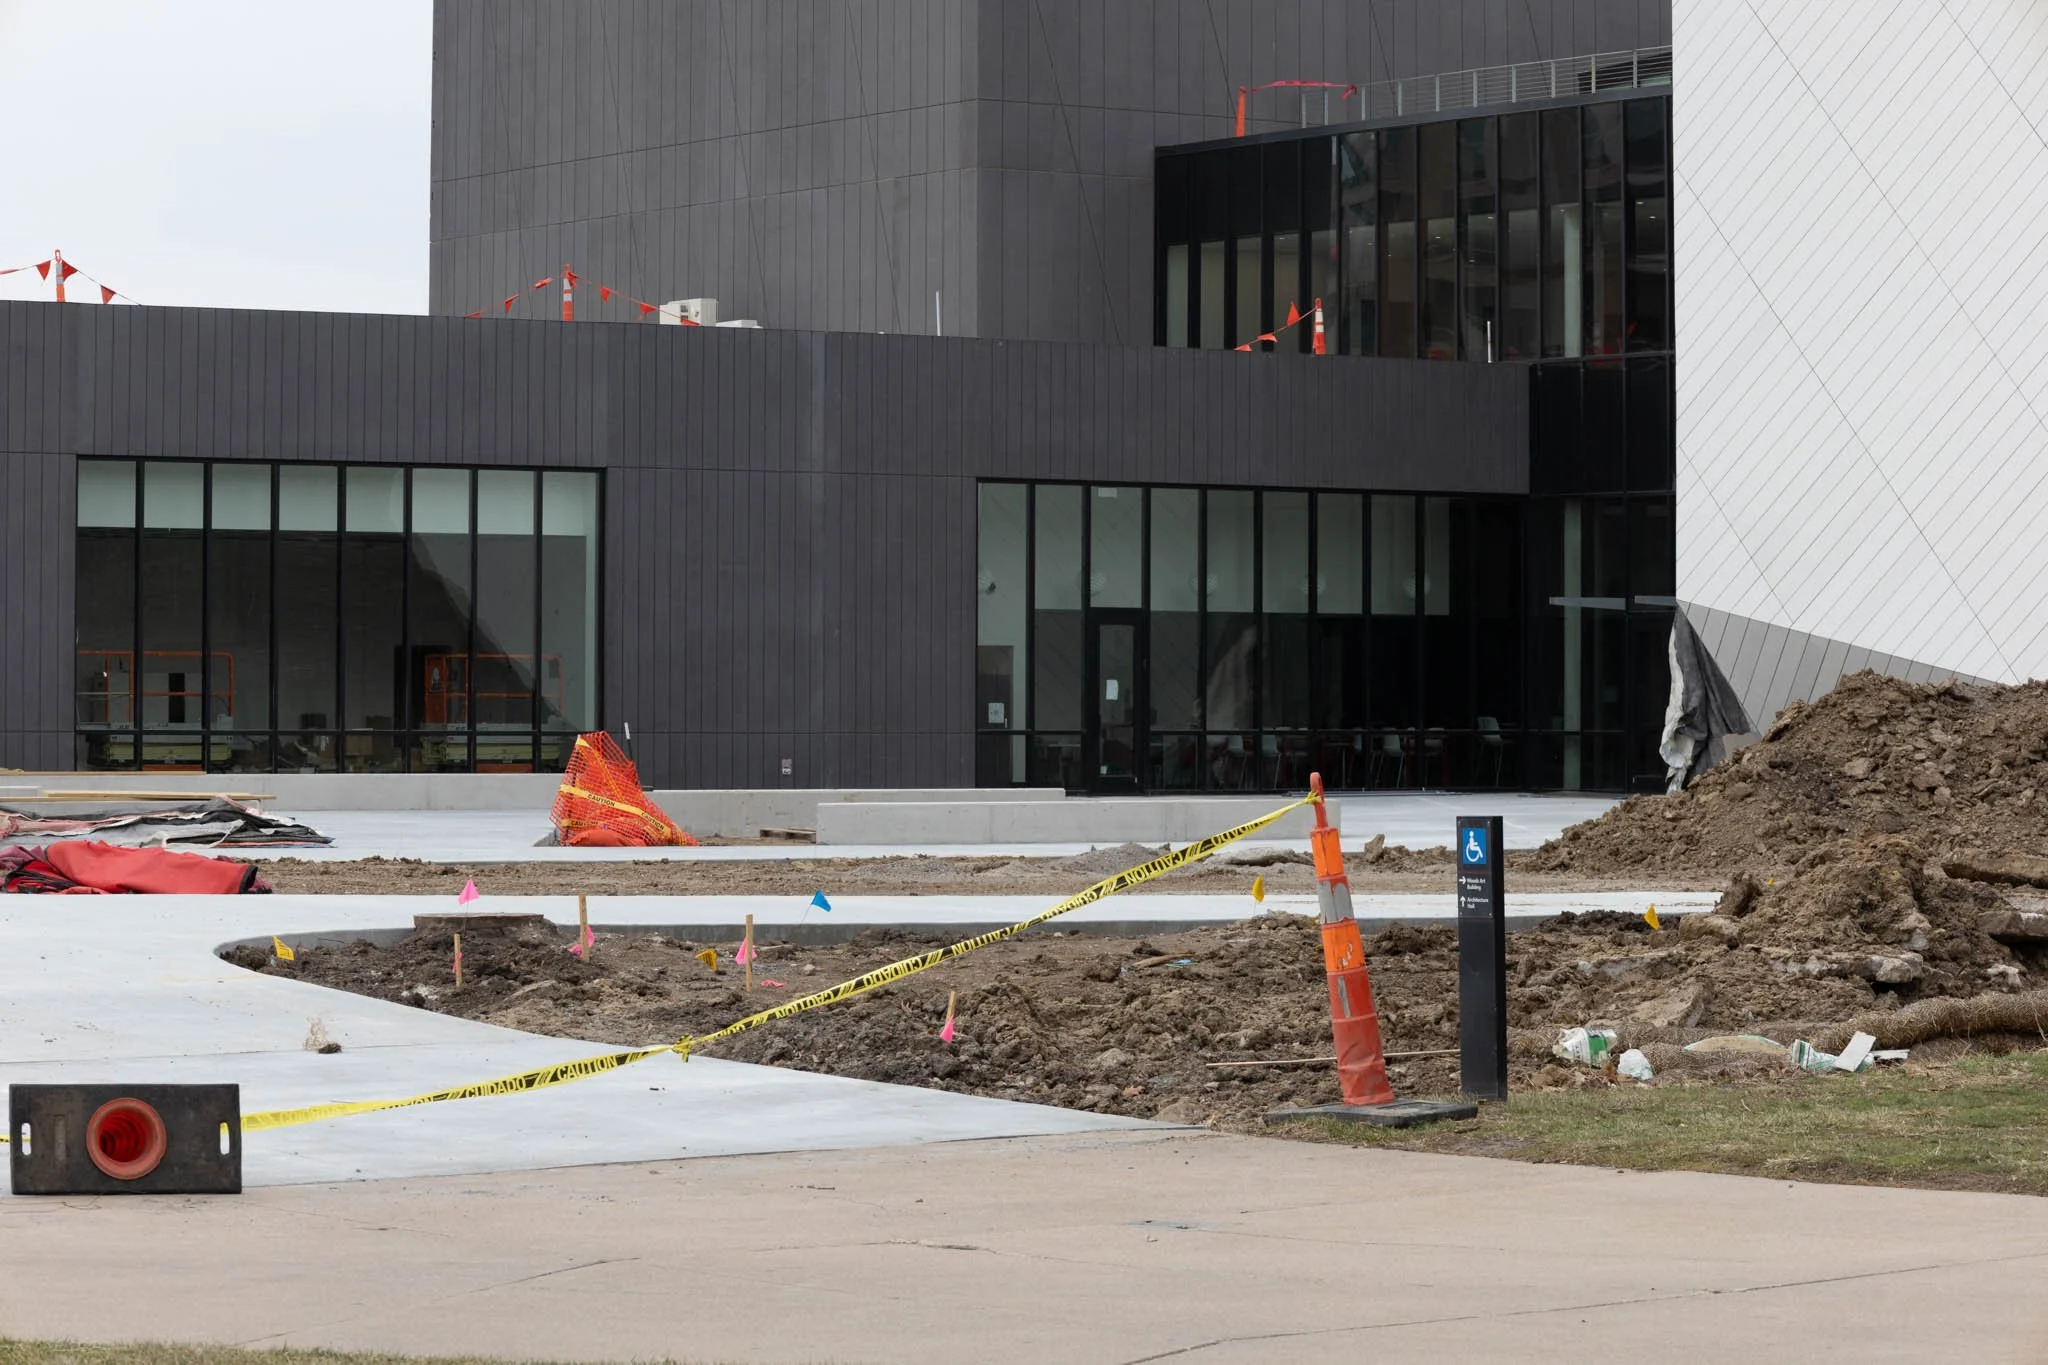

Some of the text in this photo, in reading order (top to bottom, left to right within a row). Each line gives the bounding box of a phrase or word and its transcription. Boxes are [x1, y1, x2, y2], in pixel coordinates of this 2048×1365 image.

[587, 793, 615, 807] CAUTION
[641, 812, 665, 831] CAUTION
[774, 990, 835, 1019] CAUTION
[863, 957, 923, 987] CUIDADO
[952, 927, 1011, 957] CAUTION
[1125, 851, 1183, 884] CAUTION
[466, 1056, 617, 1098] CUIDADO CAUTION
